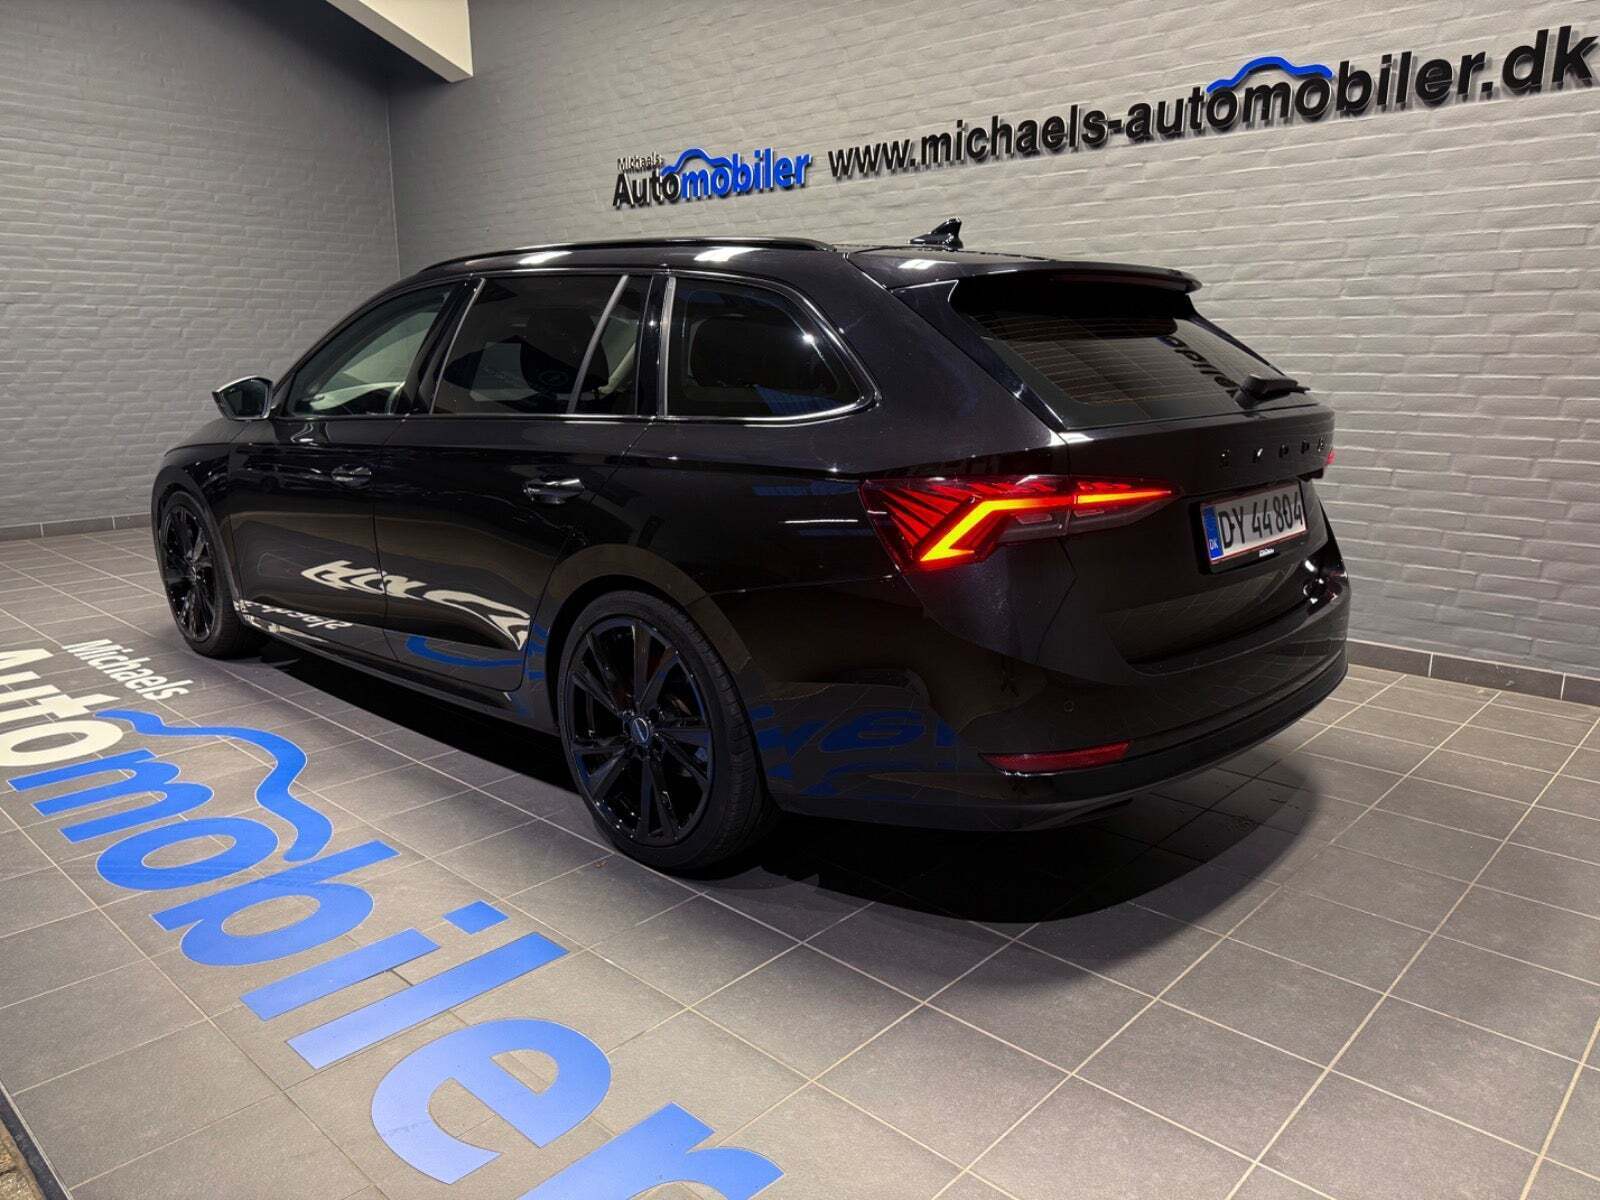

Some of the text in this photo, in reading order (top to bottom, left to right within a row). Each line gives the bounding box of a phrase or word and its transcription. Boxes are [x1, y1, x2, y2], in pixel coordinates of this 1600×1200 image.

[828, 25, 1599, 177] www.michaels-automobiler.dk
[612, 147, 812, 209] Automobiler
[616, 151, 664, 173] Michaels
[1217, 506, 1246, 549] DY
[61, 638, 194, 701] Michaels
[0, 647, 784, 1200] tomobiler
